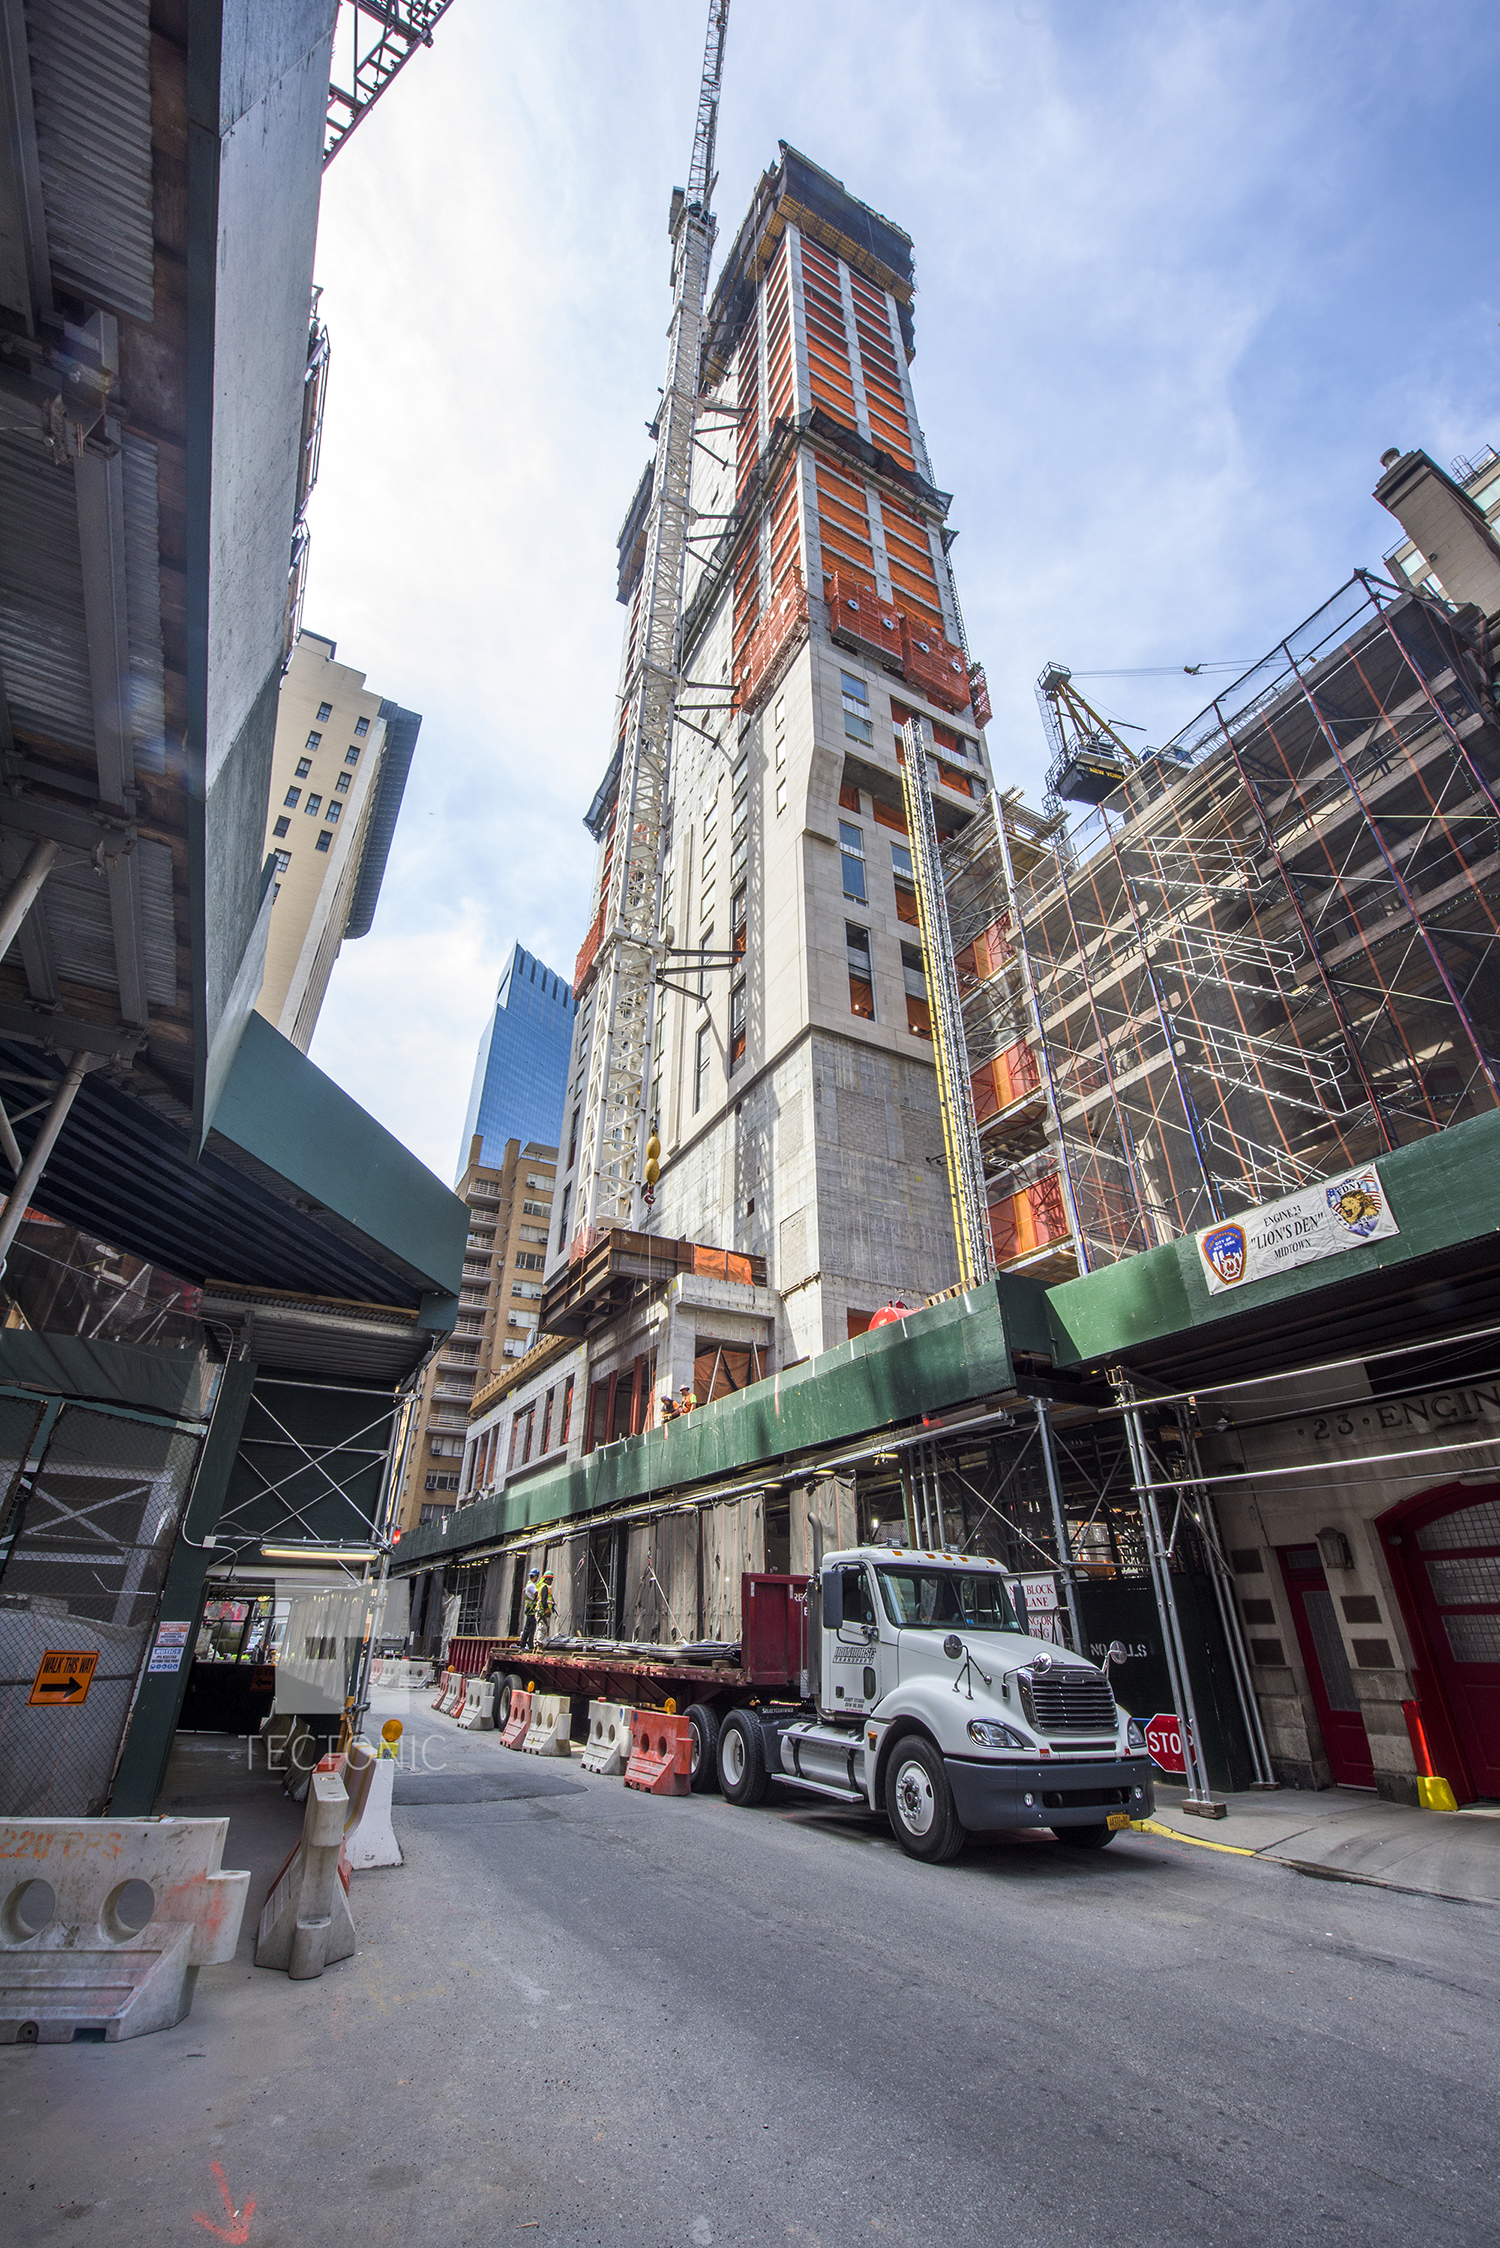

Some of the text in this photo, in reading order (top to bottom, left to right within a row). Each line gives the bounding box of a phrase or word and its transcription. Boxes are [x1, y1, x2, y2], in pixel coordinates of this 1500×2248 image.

[1336, 1181, 1363, 1196] FDNY
[1264, 1205, 1302, 1227] ENGINE 23
[1250, 1212, 1324, 1249] "LION'S DEN"
[1358, 1221, 1371, 1231] 23
[1274, 1238, 1311, 1259] MIDTOWN
[1376, 1385, 1500, 1429] ENGIN
[1027, 1583, 1054, 1595] BLOCK
[1026, 1597, 1049, 1607] LANE
[1090, 1643, 1107, 1656] NO
[43, 1657, 95, 1673] WALK THIS WAY
